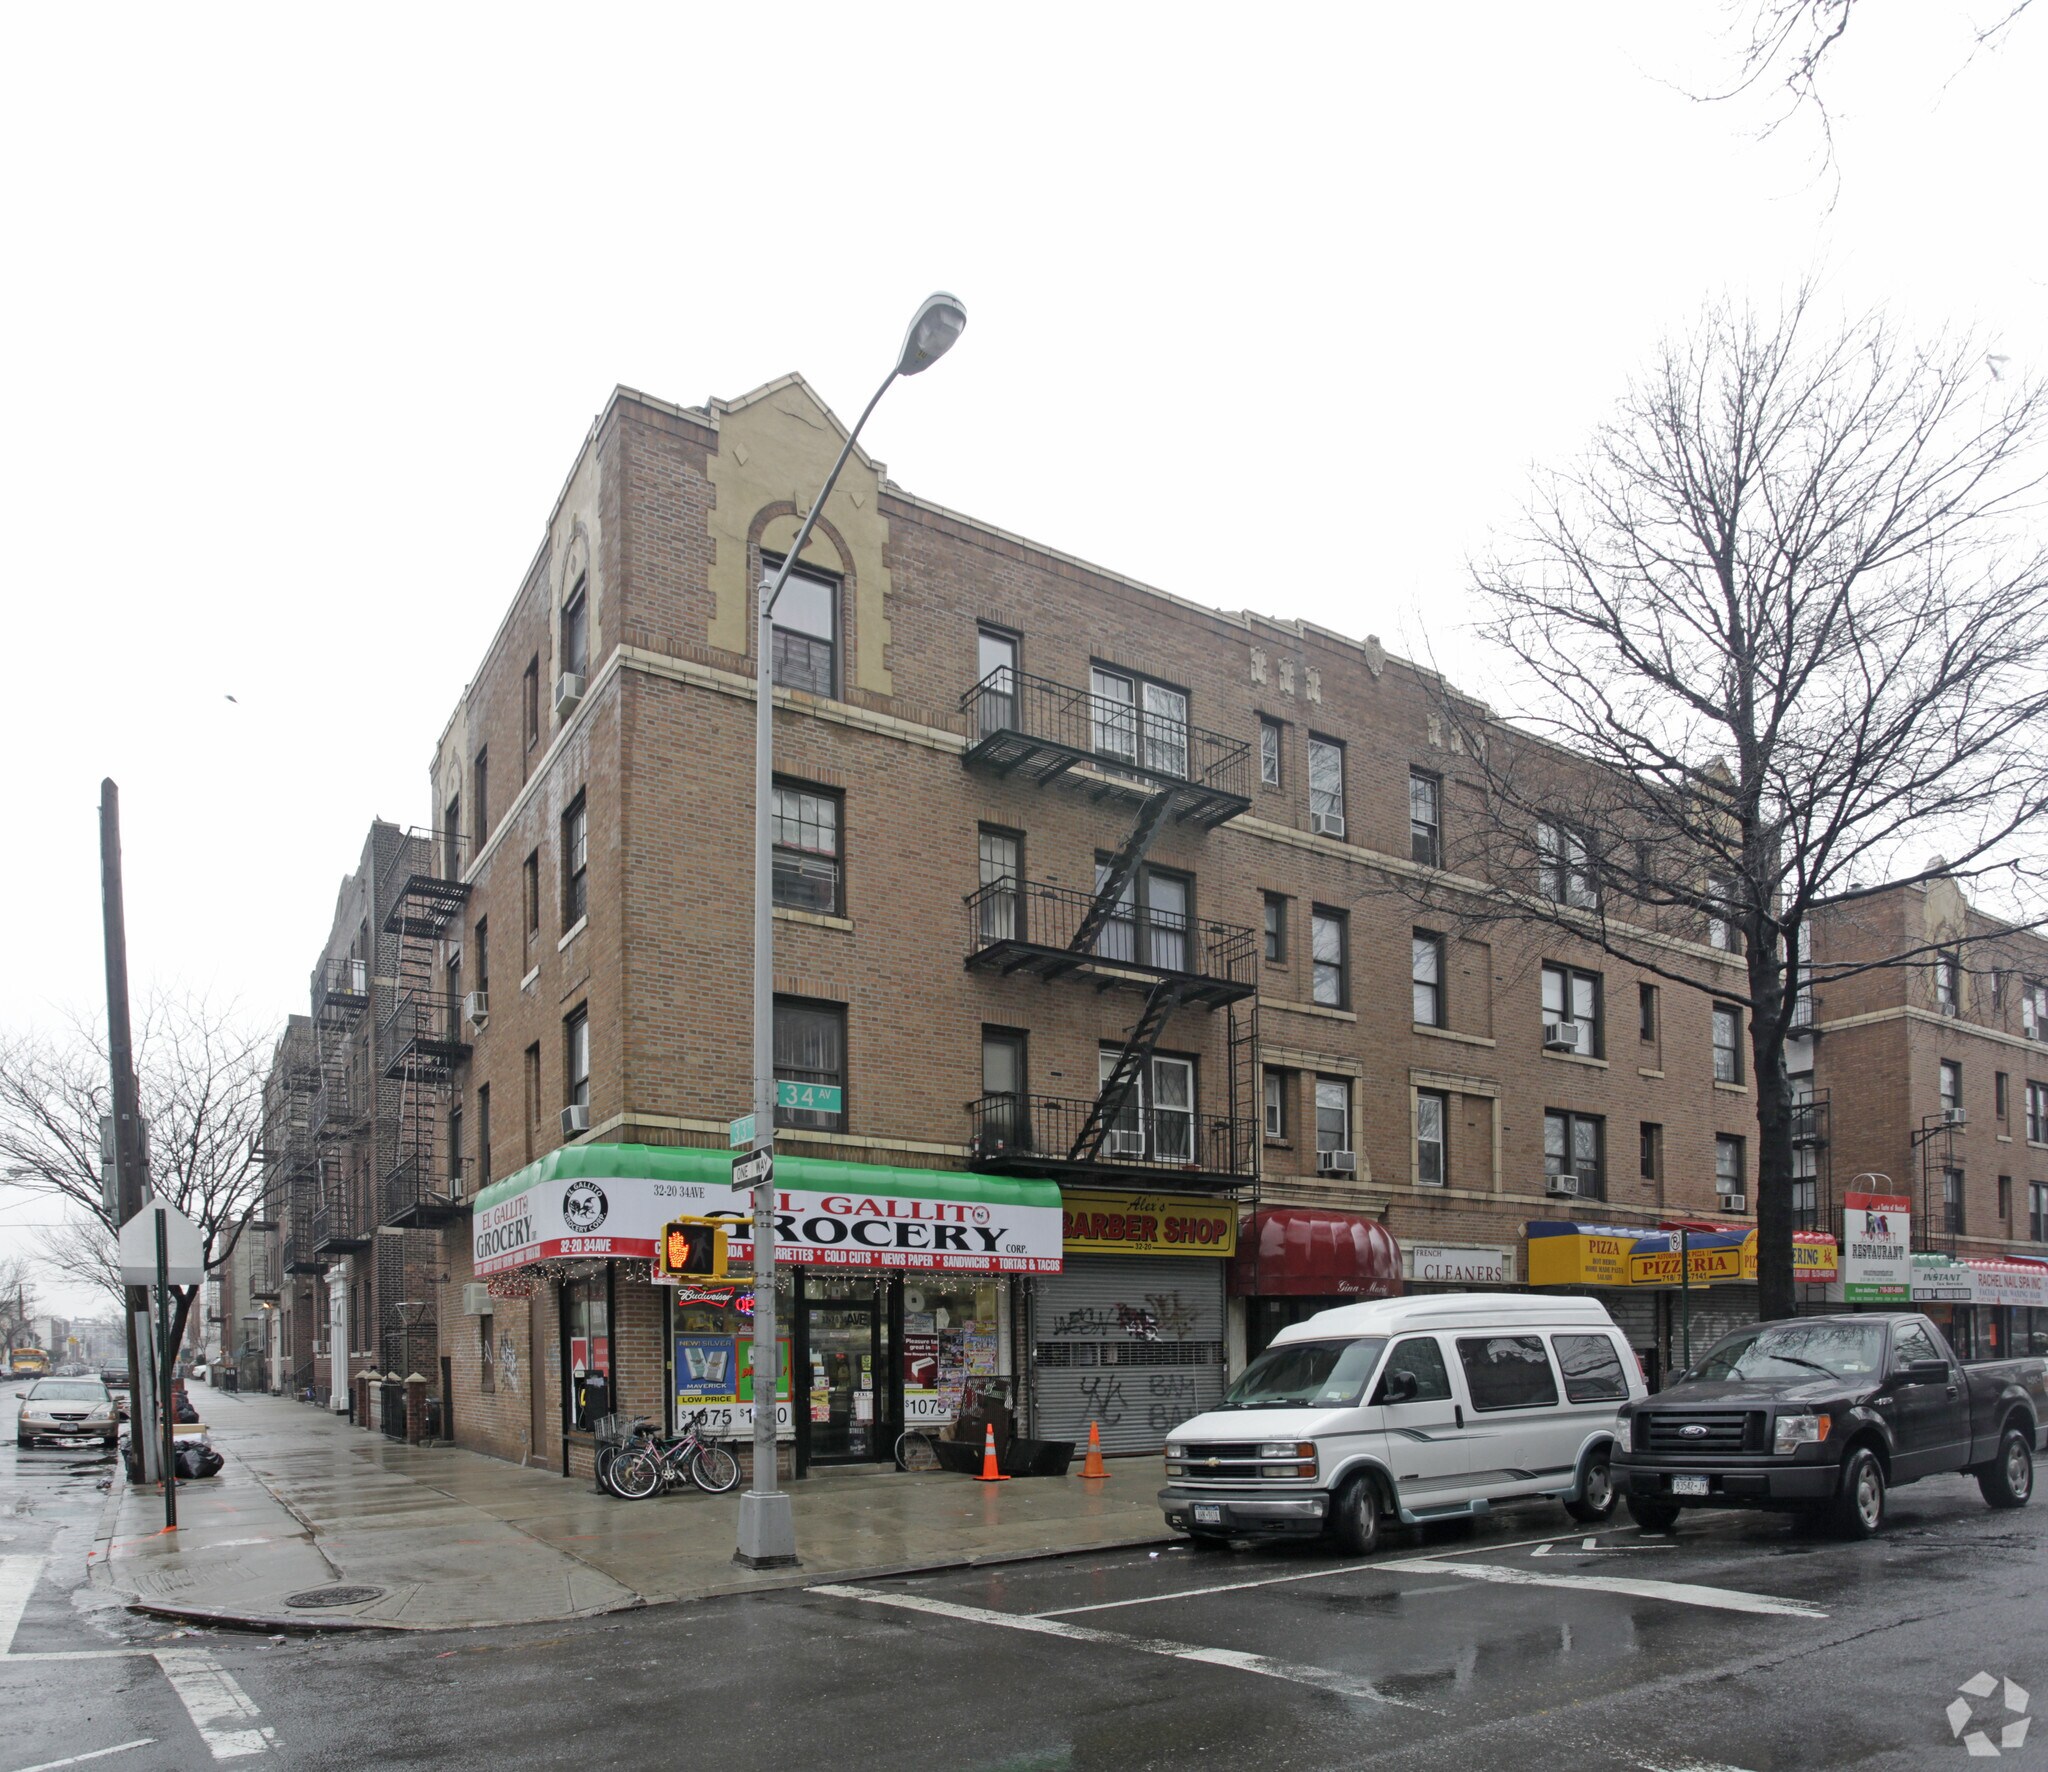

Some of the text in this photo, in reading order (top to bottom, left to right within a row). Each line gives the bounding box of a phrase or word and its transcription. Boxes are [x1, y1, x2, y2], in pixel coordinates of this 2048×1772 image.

[785, 1084, 832, 1107] 34 AV
[734, 1120, 747, 1142] 33
[736, 1157, 768, 1181] ONE WAY
[566, 1181, 603, 1198] EL GALLITO
[653, 1184, 705, 1199] 32-20 34AVE
[820, 1195, 991, 1226] GALLITO
[1126, 1195, 1166, 1212] Alex's
[482, 1195, 529, 1231] EL GALLITO
[563, 1212, 588, 1233] GROCERY
[1063, 1211, 1228, 1245] BARBER SHOP
[476, 1214, 533, 1259] GROCERY
[560, 1238, 612, 1253] 32-20 34AVE
[1005, 1243, 1028, 1254] CORP.
[1134, 1242, 1152, 1251] 32-20
[1416, 1249, 1442, 1258] FRENCH
[1588, 1239, 1620, 1256] PIZZA
[1852, 1243, 1905, 1261] RESTAURANT
[824, 1249, 847, 1263] COLD
[849, 1251, 872, 1264] CUTS
[881, 1252, 906, 1266] NEWS
[908, 1253, 933, 1267] PAPER
[943, 1254, 990, 1269] SANDWICHS
[999, 1257, 1027, 1271] TORTAS
[1028, 1258, 1036, 1270] &
[1036, 1259, 1060, 1272] TACOS
[1792, 1248, 1819, 1265] ERING
[1424, 1264, 1502, 1282] CLEANERS
[1923, 1273, 1961, 1282] INSTANT
[1978, 1273, 2003, 1288] RACHEL
[2004, 1274, 2018, 1288] NAIL
[2018, 1275, 2031, 1289] SPA
[1337, 1279, 1359, 1292] Gina
[1366, 1281, 1388, 1293] Marie
[678, 1289, 733, 1301] Budweiser
[706, 1395, 732, 1403] PRICE
